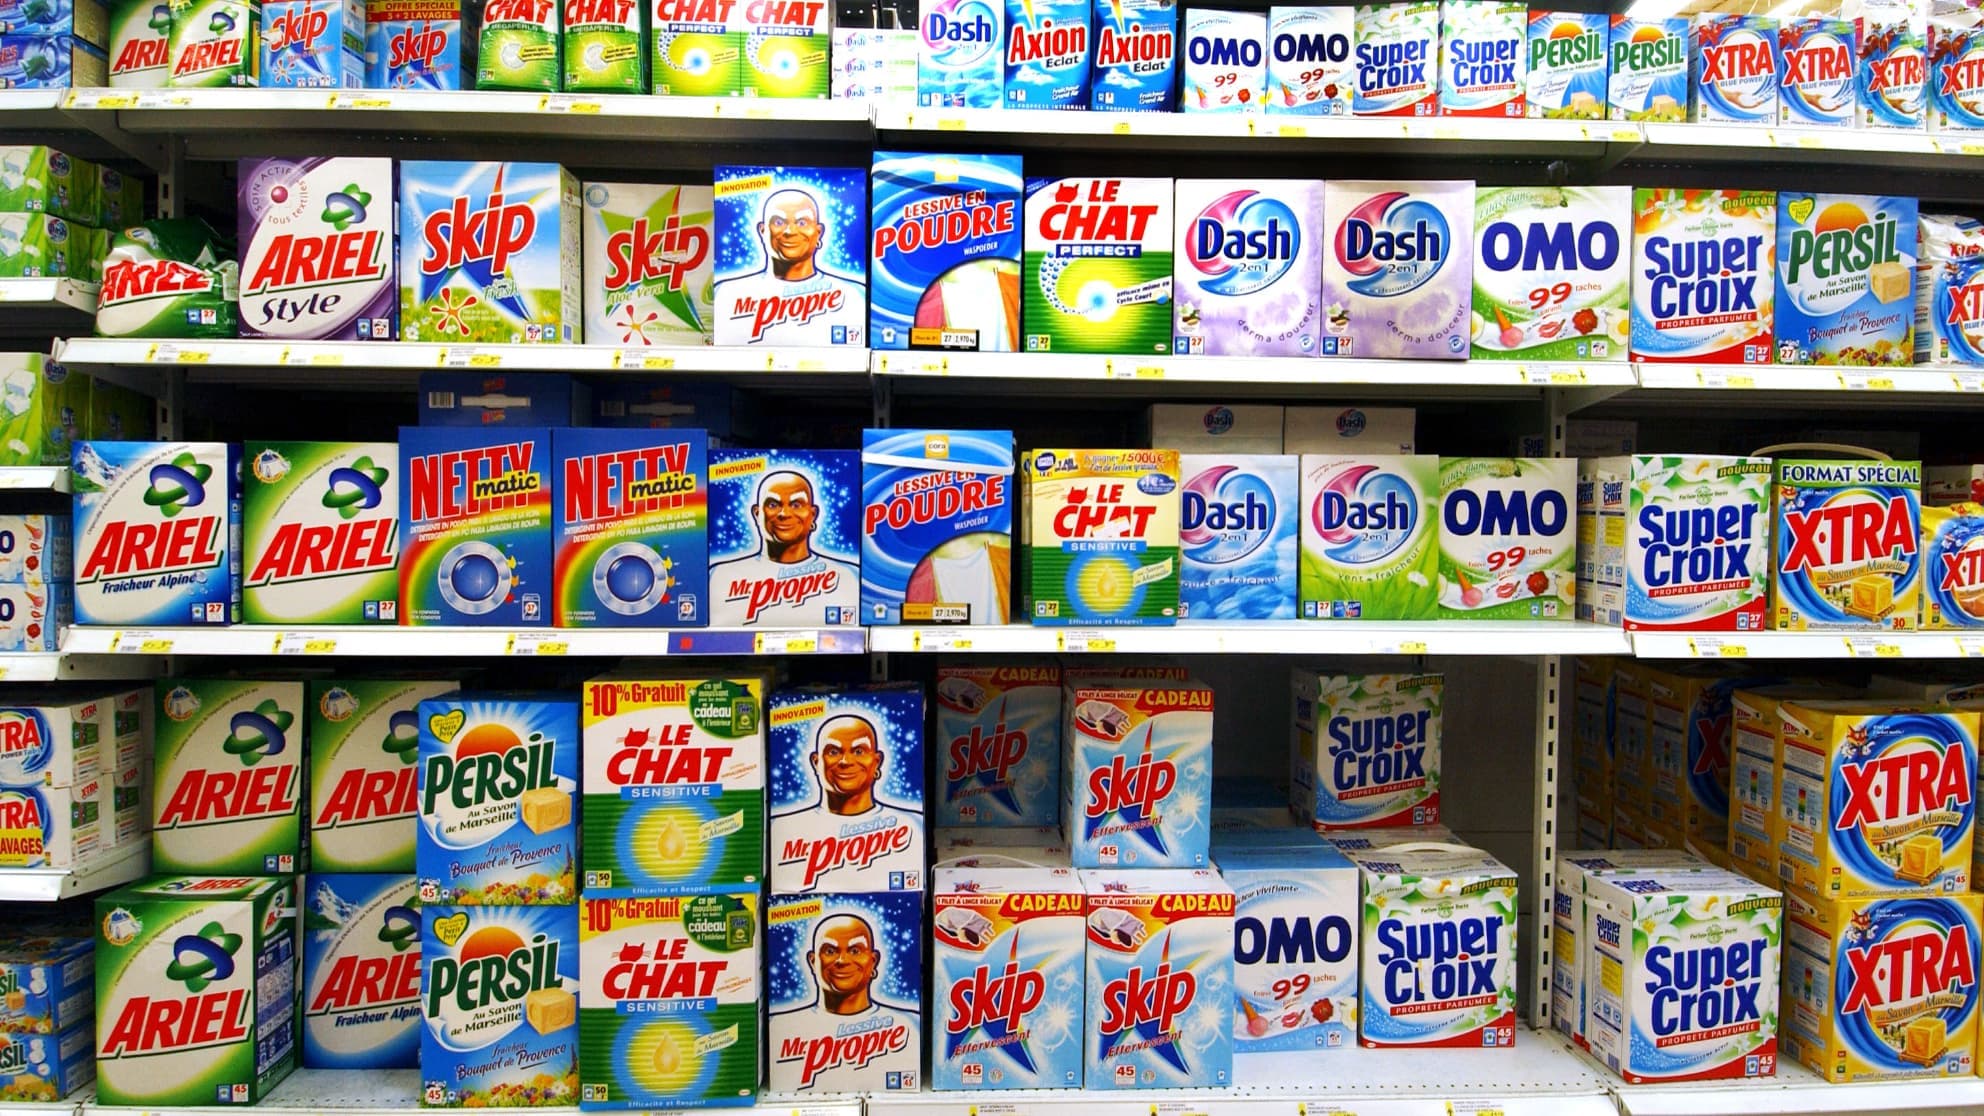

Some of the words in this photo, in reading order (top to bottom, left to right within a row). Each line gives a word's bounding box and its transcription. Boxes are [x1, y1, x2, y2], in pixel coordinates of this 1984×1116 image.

[484, 0, 553, 24] CHAT
[564, 0, 635, 25] CHAT
[656, 0, 736, 23] CHAT
[745, 0, 824, 26] CHAT
[669, 24, 724, 34] PERFECT
[759, 26, 811, 36] PERFECT
[930, 12, 990, 42] Dash
[1009, 21, 1086, 63] Axion
[1098, 23, 1172, 65] Axion
[1189, 36, 1262, 67] OMO
[1273, 33, 1350, 63] OMO
[1355, 39, 1430, 69] Super
[1449, 39, 1519, 69] Super
[172, 38, 243, 75] ARIEL
[1359, 61, 1426, 92] Croix
[1453, 60, 1517, 87] Croix
[252, 182, 263, 212] SOIN
[260, 166, 292, 181] ACTIF
[720, 180, 768, 192] INNOVATION
[1088, 180, 1121, 203] LE
[905, 195, 963, 219] LESSIVE
[966, 191, 986, 204] EN
[874, 202, 1014, 258] POUDRE
[1039, 204, 1159, 242] CHAT
[963, 241, 999, 255] WASPOEDER
[1060, 244, 1138, 257] PERFECT
[1197, 219, 1291, 260] Dash
[1347, 219, 1441, 261] Dash
[1481, 220, 1620, 272] OMO
[248, 231, 381, 288] ARIEL
[1644, 234, 1764, 279] Super
[1575, 284, 1602, 294] taches
[1818, 281, 1867, 299] Marseille
[1839, 274, 1867, 285] Savon
[1528, 282, 1572, 310] 99
[1650, 270, 1758, 319] Croix
[261, 293, 341, 326] Style
[1238, 319, 1272, 343] derma
[1278, 302, 1315, 342] douceur
[1387, 319, 1421, 344] derma
[1428, 303, 1466, 342] douceur
[1807, 324, 1849, 342] Bouquet
[1860, 312, 1901, 333] Provence
[410, 441, 534, 522] NETTY
[565, 443, 690, 523] NETTY
[714, 462, 761, 476] INNOVATION
[1782, 465, 1853, 481] FORMAT
[1857, 462, 1920, 482] SPÉCIAL
[475, 474, 537, 498] matic
[631, 472, 693, 499] matic
[895, 473, 953, 496] LESSIVE
[1096, 484, 1124, 503] LE
[865, 475, 1004, 534] POUDRE
[1182, 490, 1267, 531] Dash
[1323, 491, 1409, 531] Dash
[1444, 489, 1567, 537] OMO
[1053, 505, 1156, 538] CHAT
[1638, 503, 1759, 547] Super
[86, 516, 215, 577] ARIEL
[249, 518, 393, 581] ARIEL
[1071, 542, 1137, 552] SENSITIVE
[1486, 547, 1526, 571] 99
[1528, 548, 1553, 557] taches
[1643, 538, 1751, 587] Croix
[1828, 568, 1857, 580] Savon
[1866, 559, 1906, 574] Marseille
[1892, 617, 1905, 628] 30
[631, 684, 687, 703] Gratuit
[1144, 687, 1213, 707] CADEAU
[694, 704, 732, 719] cadeau
[773, 705, 824, 722] INNOVATION
[658, 724, 694, 746] LE
[1328, 709, 1431, 757] Super
[606, 747, 733, 785] CHAT
[1333, 744, 1425, 791] Croix
[157, 764, 294, 824] ARIEL
[631, 786, 711, 798] SENSITIVE
[460, 809, 517, 832] Marseille
[482, 801, 517, 814] Savon
[1091, 815, 1164, 840] Effervescent
[450, 857, 497, 879] Bouquet
[510, 843, 562, 865] Provence
[1100, 846, 1117, 855] 45
[1009, 894, 1082, 912] CADEAU
[1161, 894, 1232, 913] CADEAU
[1255, 884, 1300, 898] Vivifiante
[625, 898, 681, 918] Gratuit
[770, 902, 821, 920] INNOVATION
[653, 939, 689, 960] LE
[1234, 915, 1353, 964] OMO
[1377, 915, 1503, 964] Super
[1643, 938, 1768, 986] Super
[602, 961, 729, 999] CHAT
[1272, 974, 1312, 1000] 99
[626, 1000, 706, 1012] SENSITIVE
[1650, 976, 1761, 1036] Croix
[101, 988, 246, 1054] ARIEL
[953, 1030, 1031, 1058] Effervescent
[963, 1065, 982, 1076] 45
[1116, 1066, 1135, 1076] 45
[233, 1084, 247, 1093] 45
